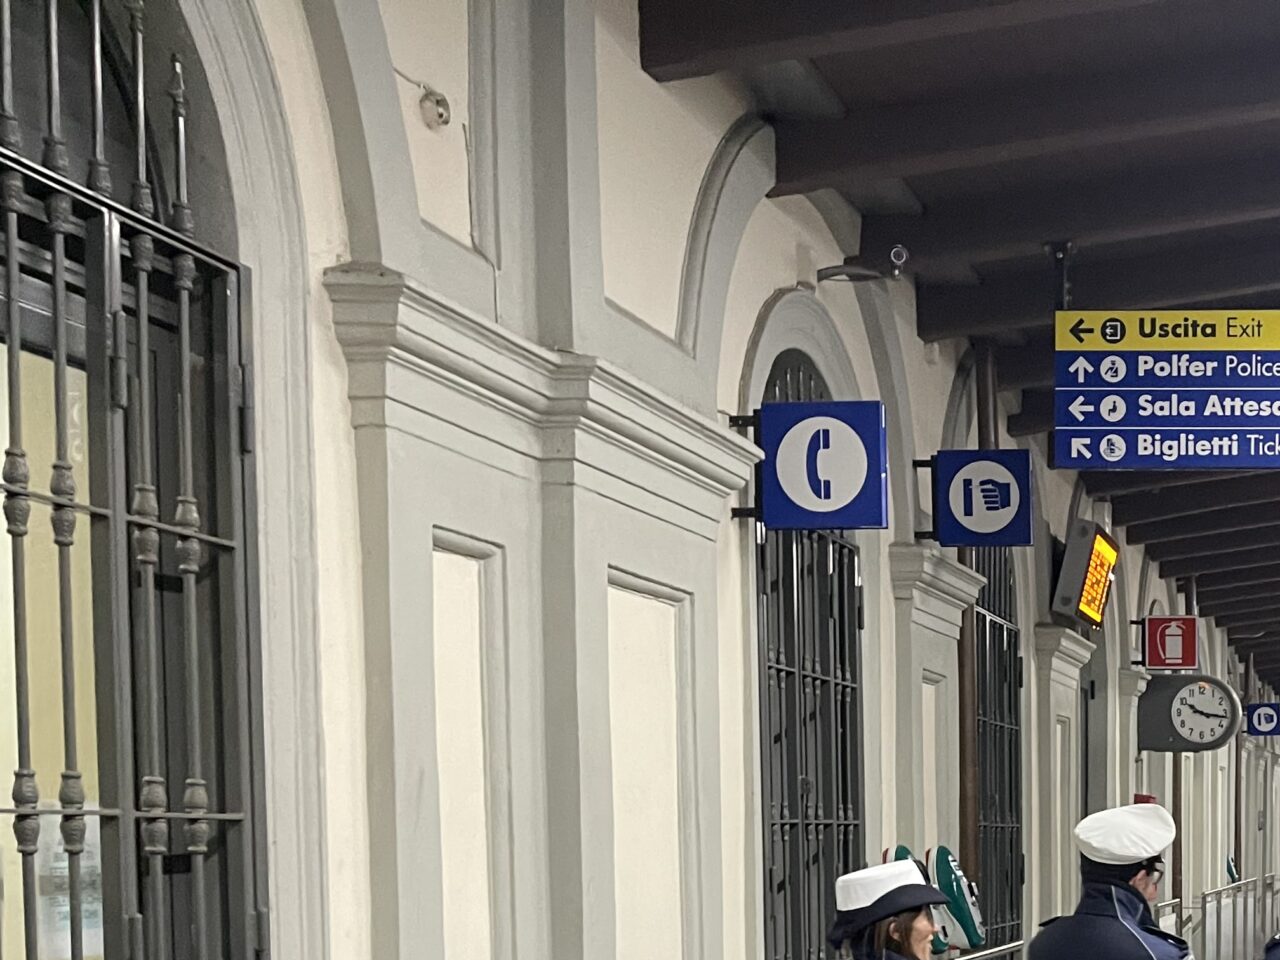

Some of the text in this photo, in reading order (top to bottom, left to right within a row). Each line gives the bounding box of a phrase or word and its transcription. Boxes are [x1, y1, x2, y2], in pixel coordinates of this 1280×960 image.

[1138, 317, 1263, 338] Uscita Exit
[1138, 354, 1218, 377] Polfer
[1138, 394, 1196, 416] Sala
[1137, 433, 1239, 462] Biglietti
[1198, 686, 1206, 695] 12
[1218, 697, 1224, 706] 2
[1176, 708, 1182, 717] 9
[1180, 720, 1186, 728] 8
[1218, 720, 1224, 728] 4
[1188, 728, 1194, 737] 7
[1199, 731, 1205, 740] 6
[1210, 728, 1216, 737] 5
